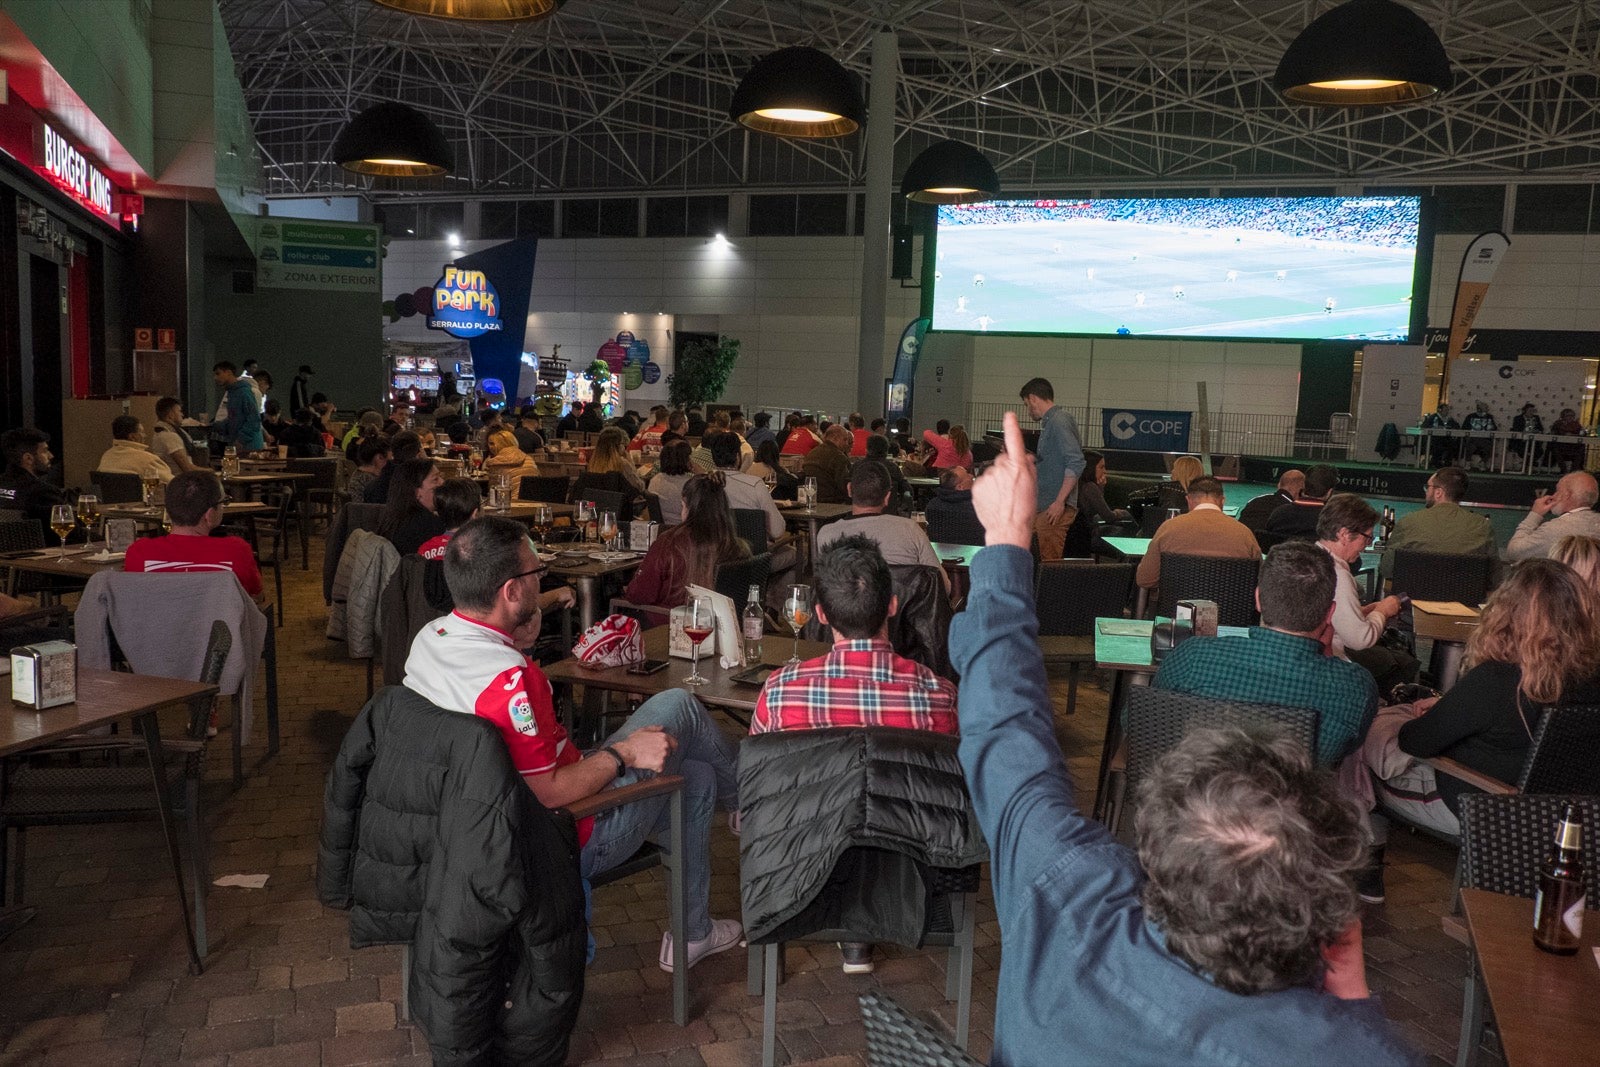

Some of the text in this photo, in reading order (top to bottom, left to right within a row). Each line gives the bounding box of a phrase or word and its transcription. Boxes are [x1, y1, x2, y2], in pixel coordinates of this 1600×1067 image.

[44, 123, 112, 215] BURGER KING
[287, 231, 345, 241] multiaventura
[287, 251, 331, 261] roller club
[284, 271, 376, 285] ZONA EXTERIOR
[445, 267, 487, 291] Fun
[431, 320, 501, 331] SERRALLO PLAZA
[1514, 368, 1537, 377] COPE
[1139, 419, 1183, 435] COPE
[422, 546, 445, 560] ORG
